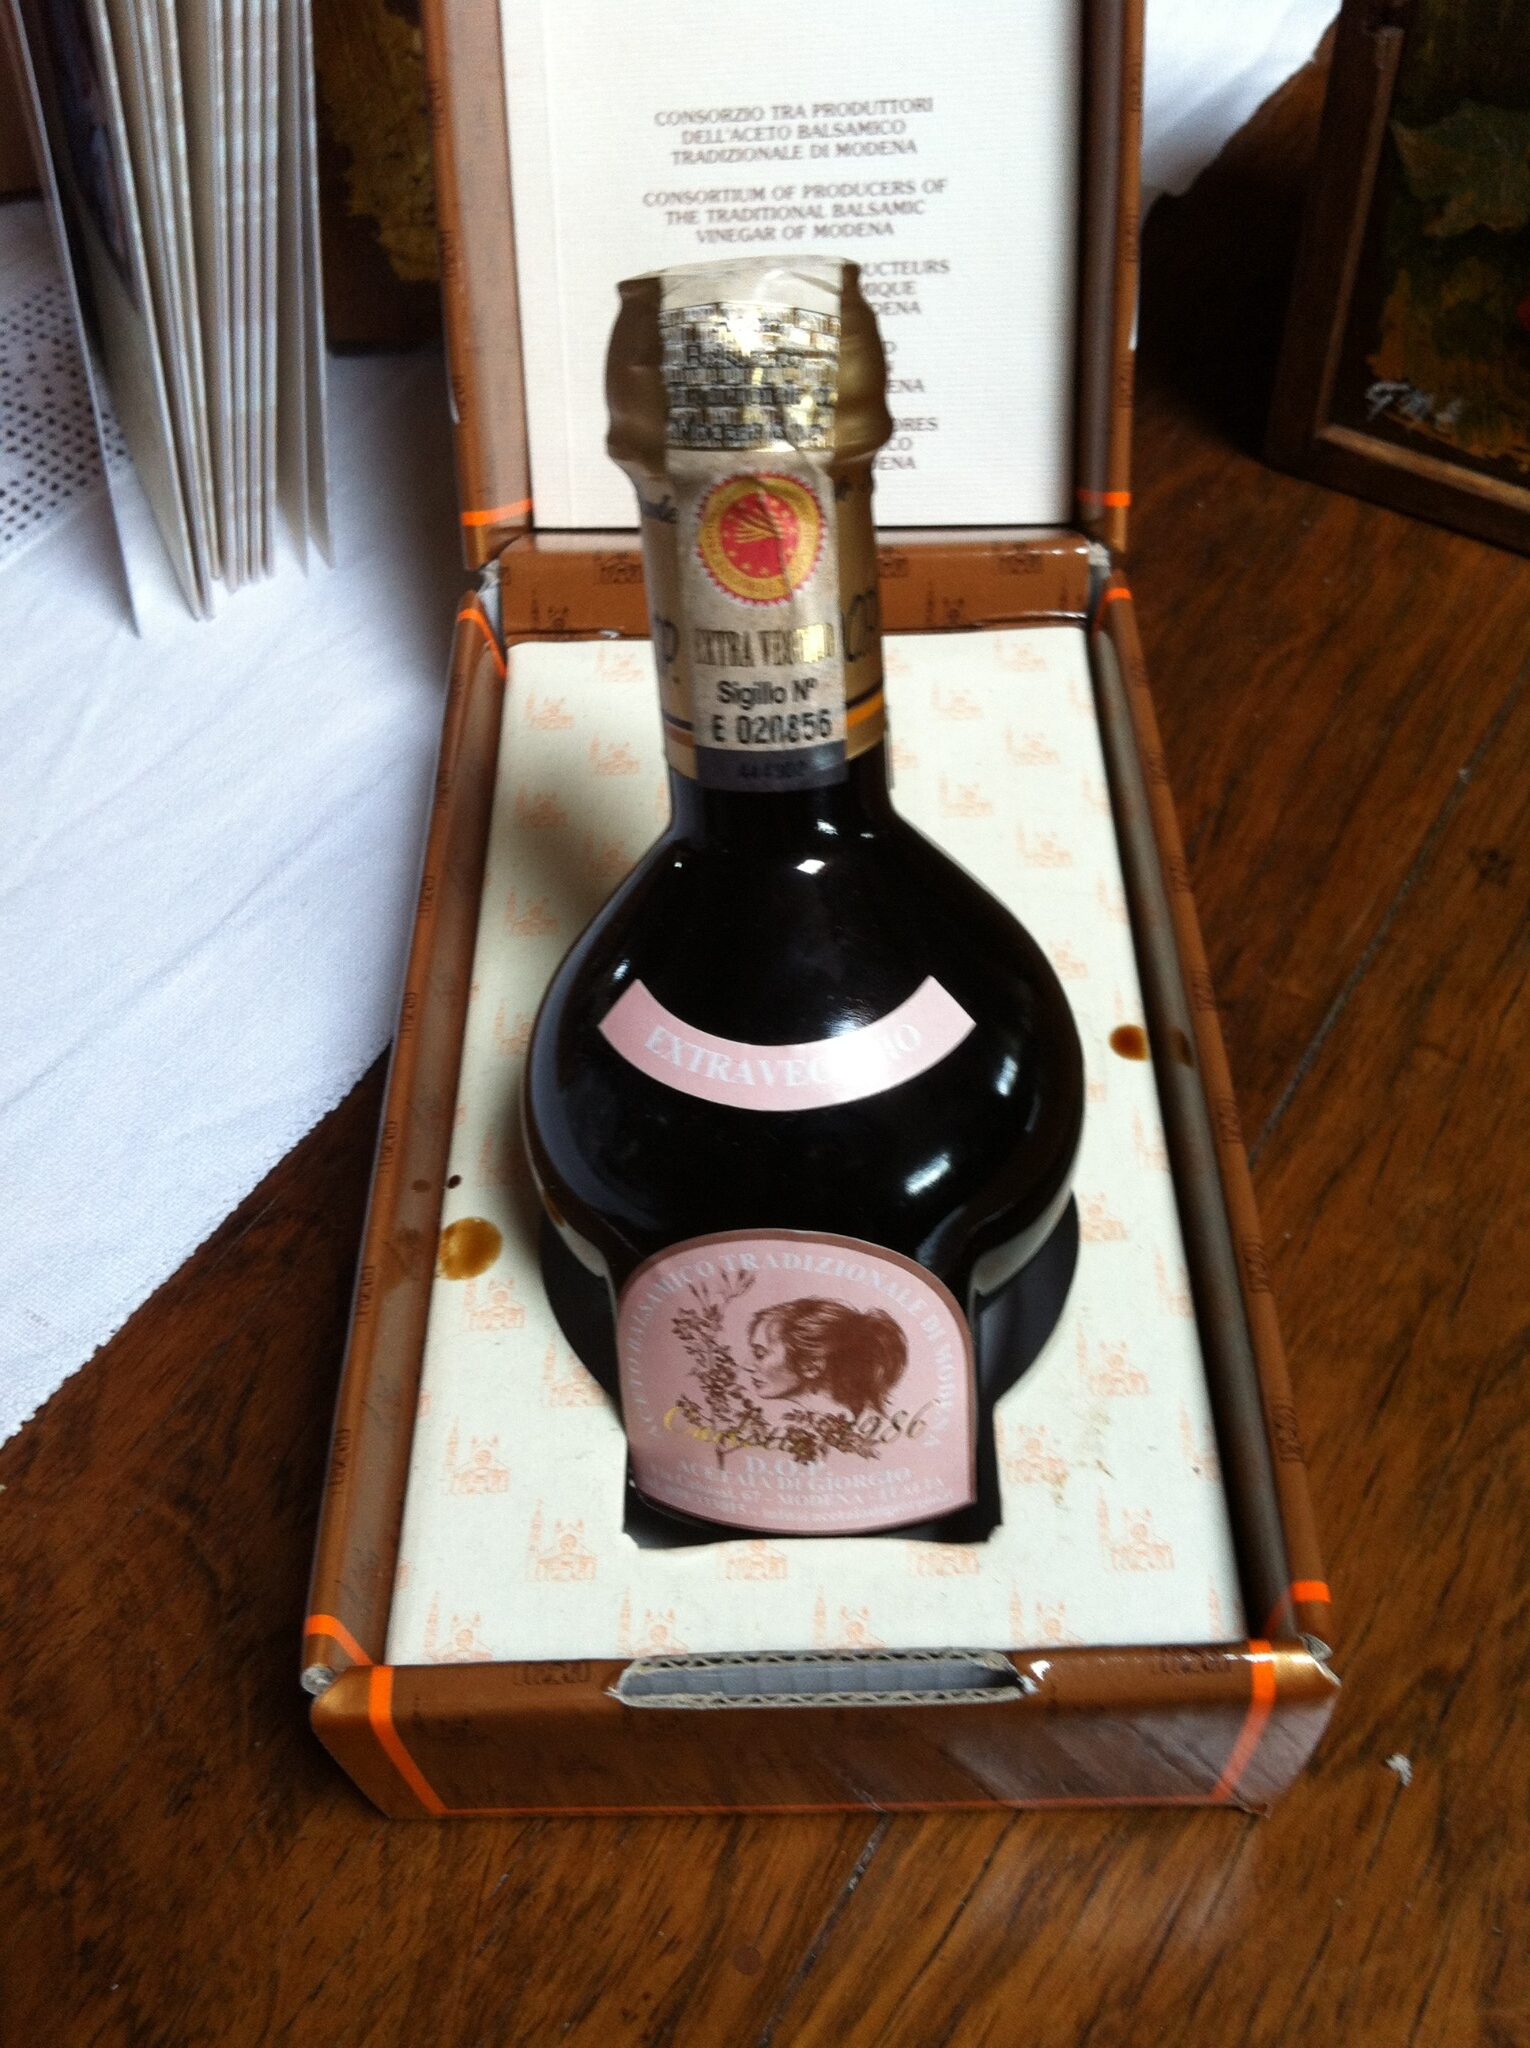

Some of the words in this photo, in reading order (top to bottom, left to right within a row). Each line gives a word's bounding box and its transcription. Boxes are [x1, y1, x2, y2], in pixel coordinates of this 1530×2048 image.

[654, 107, 764, 126] CONSORZIO
[771, 104, 806, 121] TRA
[812, 98, 934, 119] PRODUTTORI
[682, 125, 791, 145] DELL'ACETO
[798, 119, 906, 140] BALSAMICO
[672, 145, 802, 165] TRADIZIONALE
[810, 144, 830, 159] DI
[836, 139, 918, 157] MODENA
[643, 186, 765, 208] CONSORTIUM
[772, 185, 797, 201] OF
[803, 180, 916, 200] PRODUCERS
[922, 178, 947, 194] OF
[666, 210, 697, 225] THE
[706, 204, 824, 223] TRADITIONAL
[832, 200, 926, 219] BALSAMIC
[697, 226, 775, 244] VINEGAR
[782, 225, 808, 240] OF
[813, 221, 895, 239] MODENA
[862, 260, 950, 276] UCTEURS
[885, 378, 925, 393] ENA
[875, 456, 917, 470] ENA
[717, 680, 787, 710] Sigillo
[712, 714, 725, 742] E
[720, 1252, 927, 1316] TRADIZIONALE
